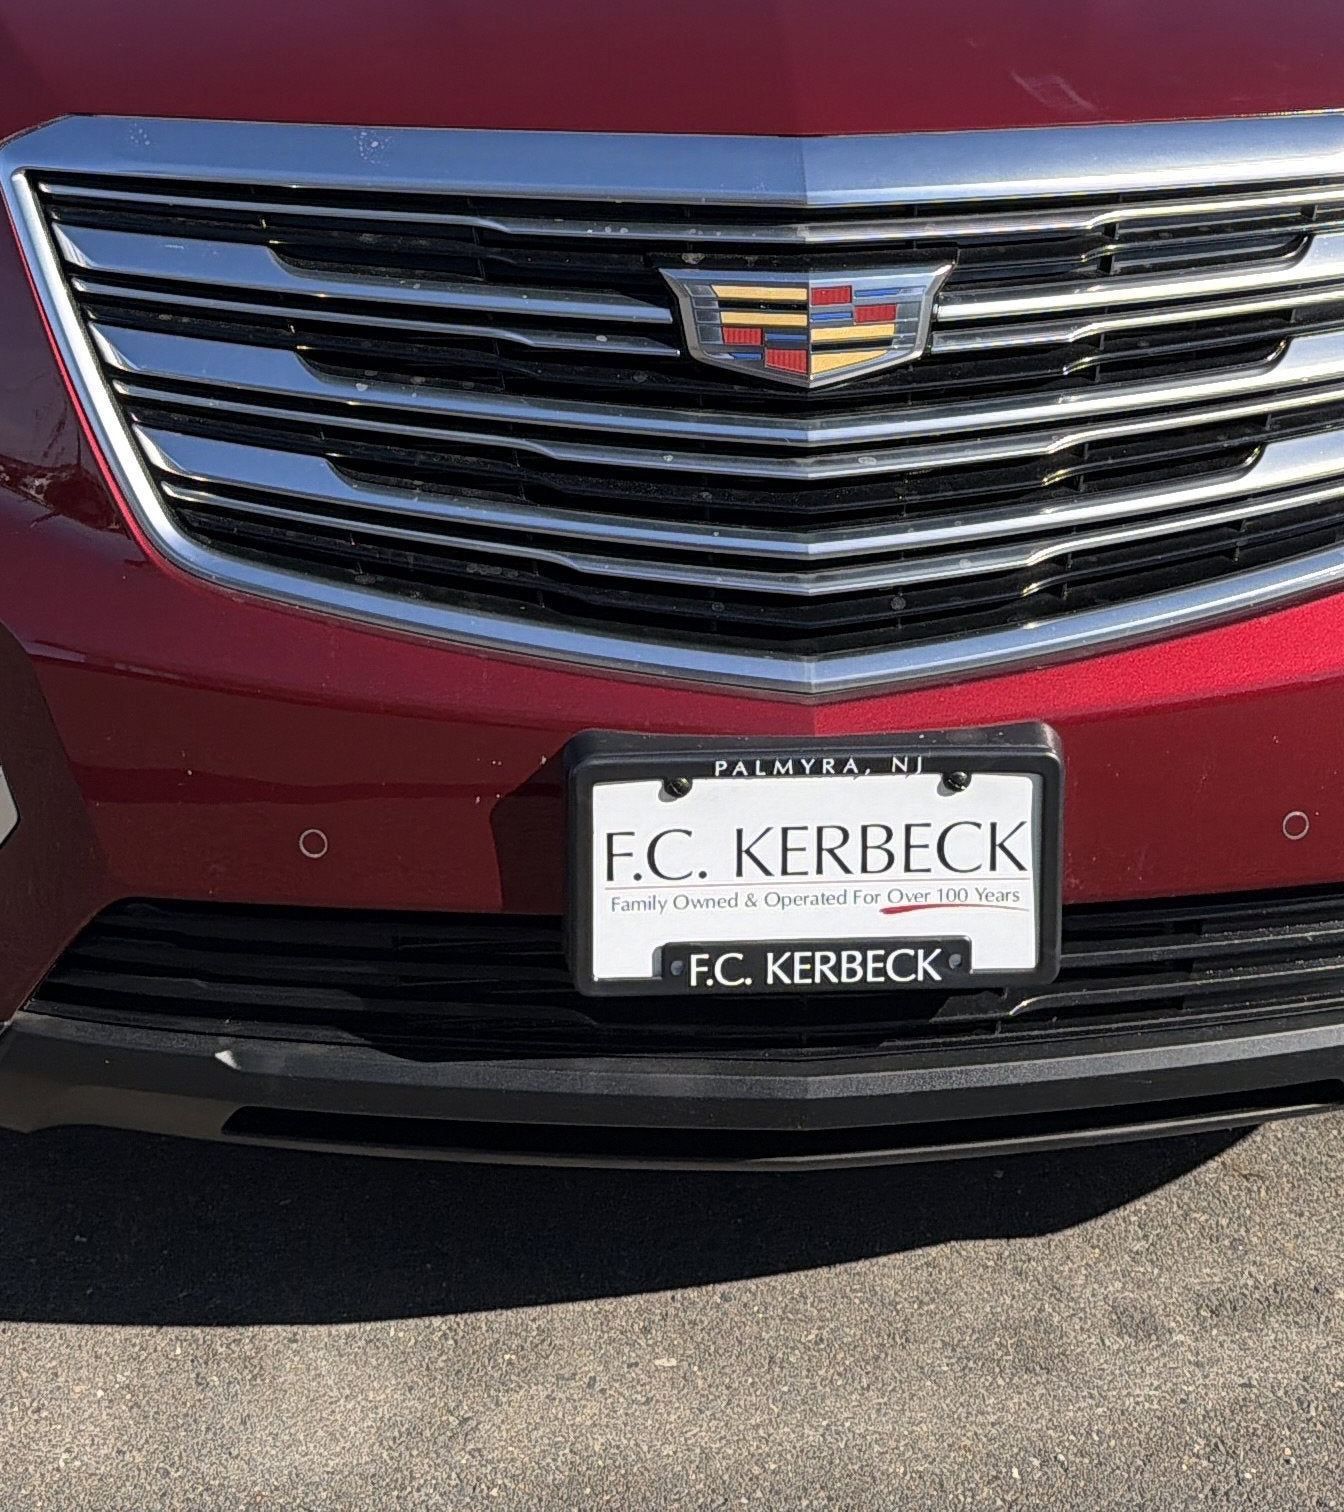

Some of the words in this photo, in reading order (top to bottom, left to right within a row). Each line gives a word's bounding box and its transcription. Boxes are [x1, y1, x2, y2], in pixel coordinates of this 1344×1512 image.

[714, 756, 873, 777] PALMYRA,
[891, 756, 925, 775] NJ
[604, 828, 708, 882] F.C.
[734, 820, 1030, 877] KERBECK
[611, 894, 668, 914] Family
[673, 893, 739, 910] Owned
[744, 892, 758, 908] &
[764, 889, 848, 910] Operated
[853, 889, 882, 905] For
[887, 888, 932, 904] Over
[937, 887, 969, 903] 100
[974, 886, 1021, 903] Years
[688, 952, 753, 987] F.C.
[766, 948, 943, 985] KERBECK
